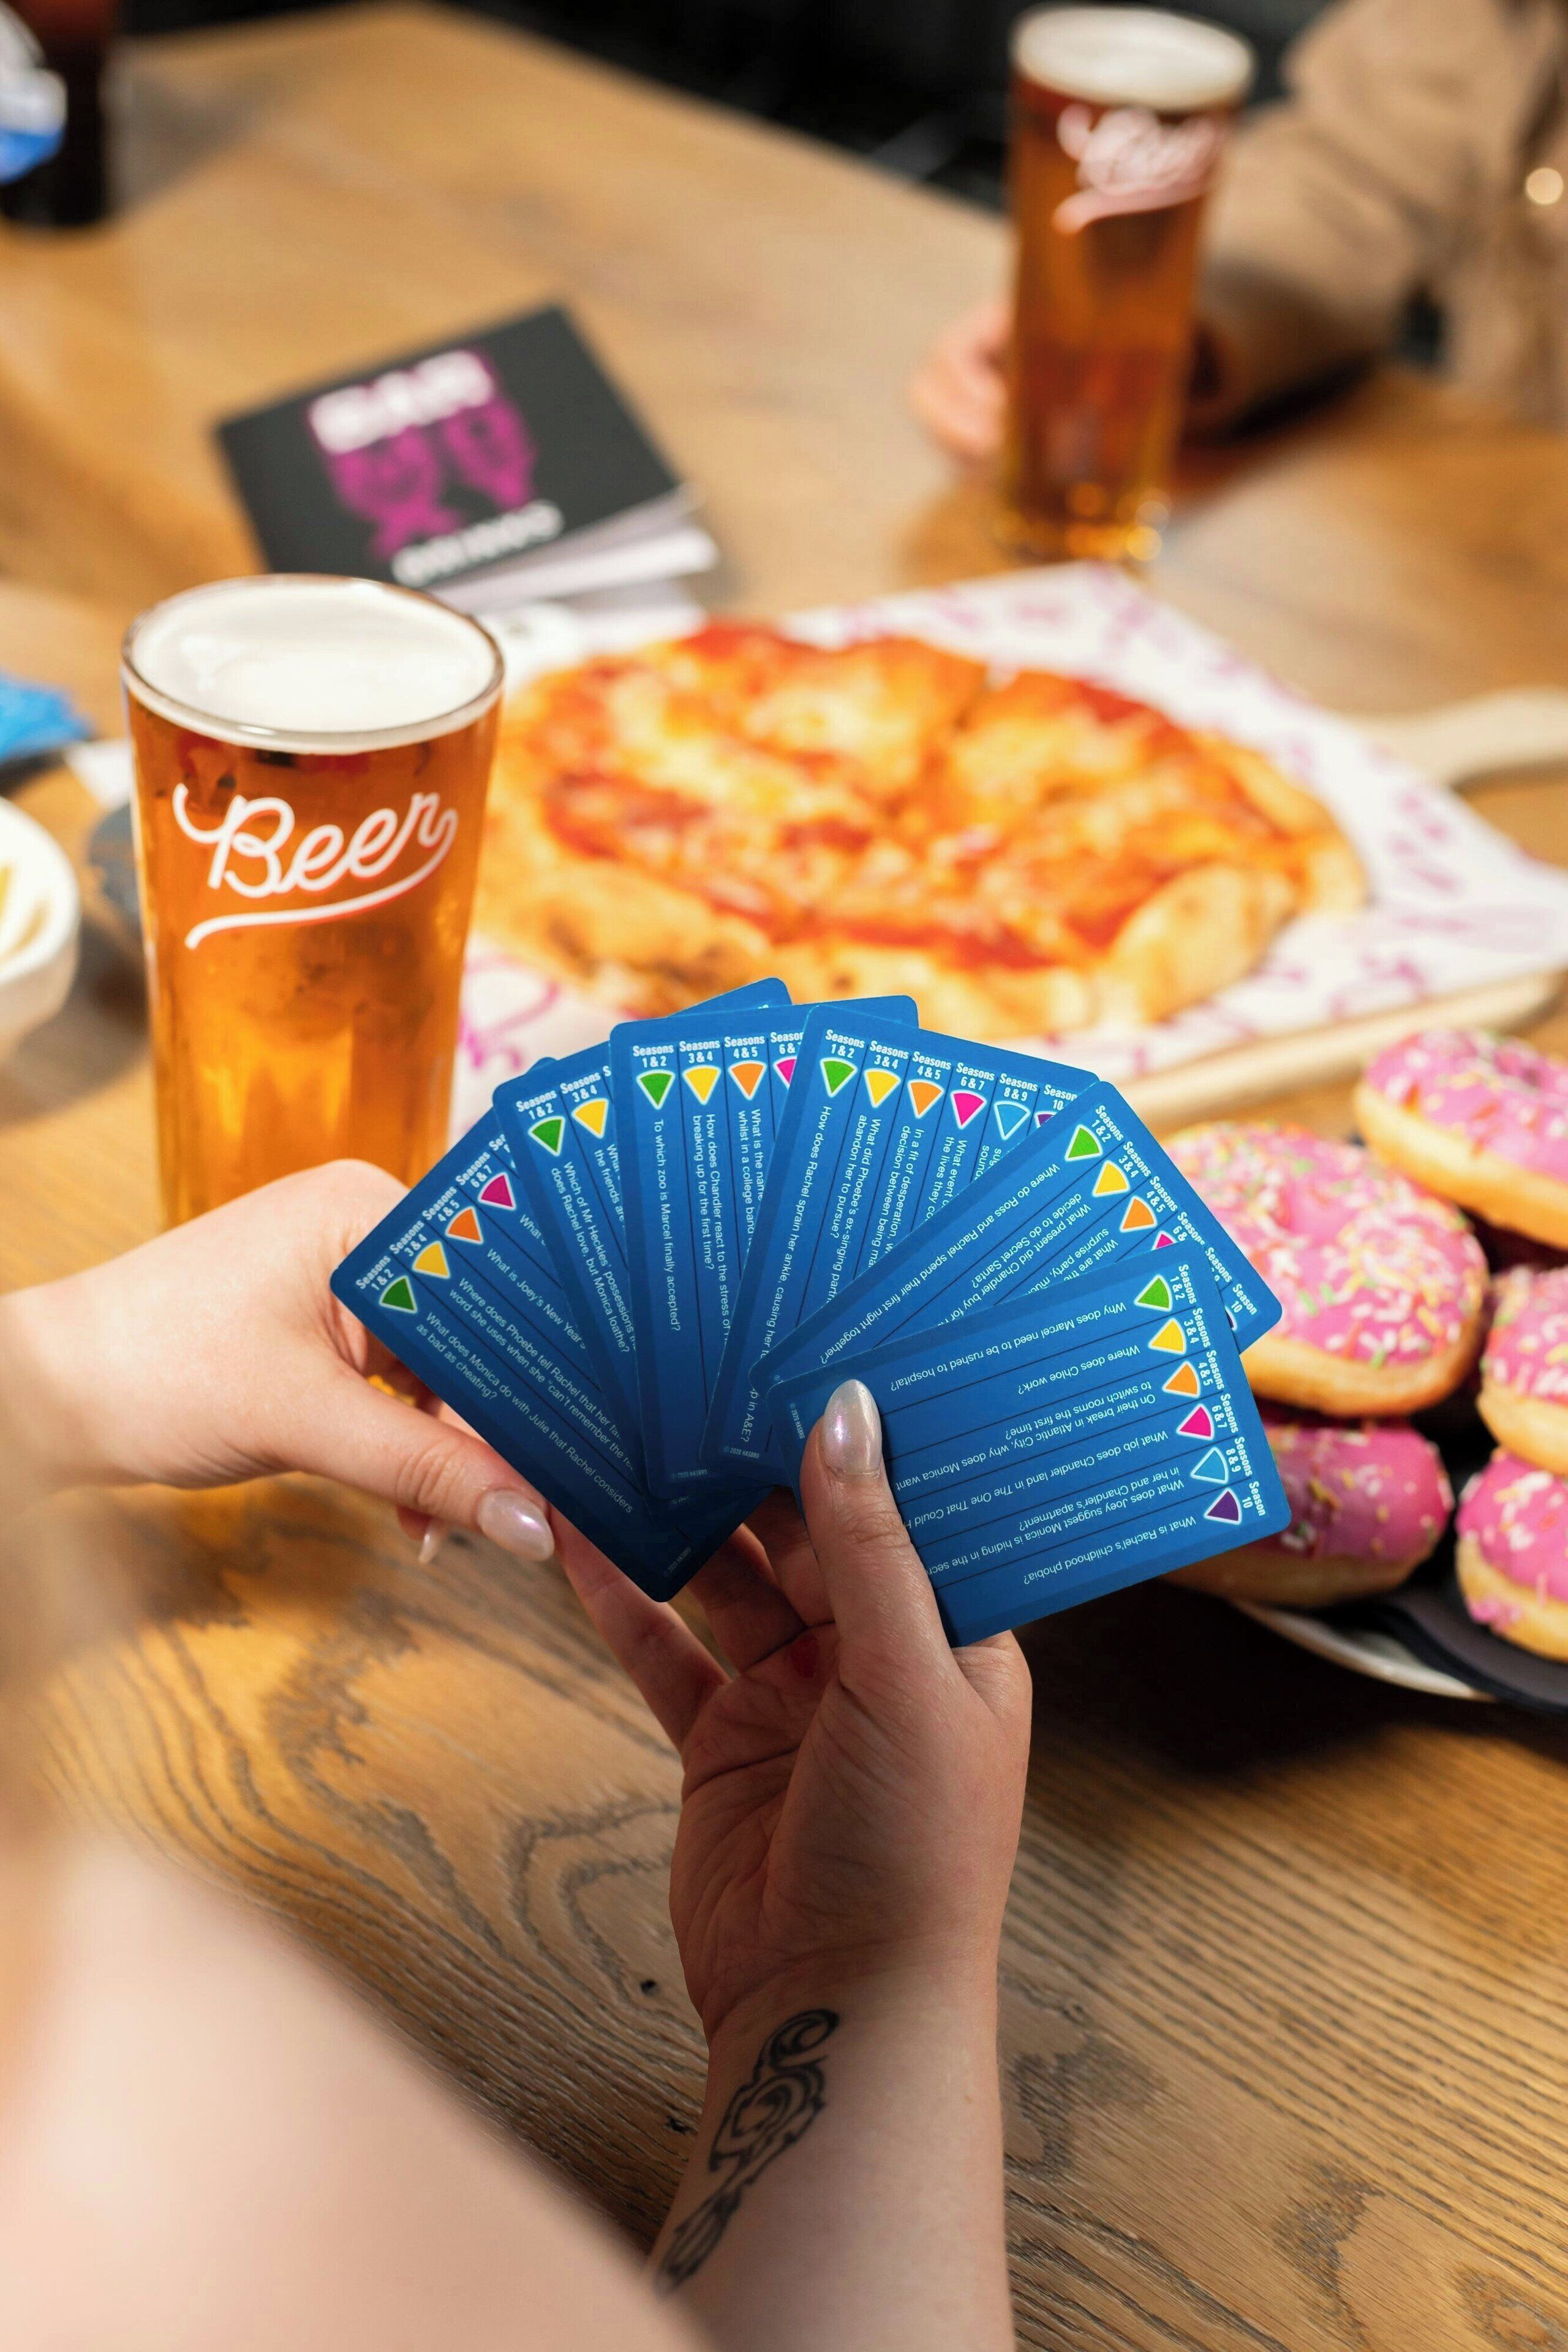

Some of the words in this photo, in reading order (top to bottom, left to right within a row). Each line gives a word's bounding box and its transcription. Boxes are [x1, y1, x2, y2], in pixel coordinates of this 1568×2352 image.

[172, 783, 458, 949] Beer
[679, 1040, 720, 1052] Seasons
[724, 1036, 764, 1047] Seasons
[825, 1029, 865, 1048] Seasons
[633, 1045, 674, 1057] Seasons
[869, 1040, 908, 1059] Seasons
[912, 1051, 951, 1069] Seasons
[956, 1062, 994, 1080] Seasons
[560, 1072, 600, 1094] Seasons
[999, 1072, 1038, 1091] Seasons
[516, 1090, 557, 1112] Seasons
[654, 1119, 663, 1132] To
[818, 1106, 832, 1130] How
[1095, 1105, 1123, 1140] Seasons
[693, 1115, 704, 1161] breaking
[810, 1133, 824, 1158] does
[849, 1115, 867, 1160] abandon
[655, 1135, 666, 1166] which
[1123, 1141, 1151, 1177] Seasons
[455, 1152, 490, 1185] Seasons
[695, 1164, 704, 1178] up
[845, 1163, 856, 1180] her
[1030, 1164, 1060, 1187] Where
[657, 1169, 666, 1188] zoo
[698, 1180, 707, 1194] for
[801, 1161, 818, 1197] Rachel
[660, 1192, 667, 1200] is
[841, 1183, 851, 1193] to
[1017, 1186, 1030, 1197] do
[1150, 1175, 1177, 1211] Seasons
[422, 1186, 456, 1220] Seasons
[699, 1197, 709, 1215] the
[994, 1196, 1019, 1216] Ross
[1052, 1193, 1081, 1218] decide
[661, 1204, 672, 1239] Marcel
[792, 1199, 805, 1231] sprain
[830, 1195, 846, 1238] pursue?
[976, 1215, 994, 1233] and
[1042, 1217, 1053, 1227] to
[701, 1218, 711, 1237] first
[1029, 1226, 1041, 1237] do
[389, 1220, 424, 1254] Seasons
[788, 1234, 799, 1251] her
[946, 1229, 978, 1257] Rachel
[664, 1242, 674, 1272] finally
[703, 1240, 714, 1269] time?
[1000, 1237, 1030, 1262] Secret
[551, 1167, 565, 1193] does
[562, 1194, 582, 1230] Rachel
[576, 1231, 589, 1256] love,
[586, 1257, 598, 1275] but
[593, 1276, 612, 1315] Monica
[608, 1316, 629, 1351] loathe?
[778, 1253, 792, 1283] ankle,
[919, 1254, 947, 1280] spend
[1205, 1246, 1232, 1282] Seasons
[355, 1256, 390, 1289] Seasons
[971, 1260, 1001, 1287] Santa?
[900, 1277, 921, 1295] their
[1178, 1264, 1196, 1304] Seasons
[666, 1276, 680, 1330] accepted?
[766, 1287, 783, 1327] causing
[881, 1294, 900, 1311] first
[1104, 1302, 1126, 1314] Why
[1231, 1300, 1242, 1313] 10
[1232, 1283, 1257, 1315] Season
[859, 1308, 882, 1329] night
[1076, 1310, 1101, 1324] does
[1041, 1319, 1074, 1338] Marcel
[1193, 1308, 1210, 1347] Seasons
[764, 1330, 775, 1347] her
[820, 1327, 861, 1363] together?
[1013, 1332, 1038, 1348] need
[986, 1345, 999, 1355] be
[1107, 1345, 1140, 1360] Where
[416, 1324, 428, 1335] as
[427, 1333, 447, 1352] bad
[444, 1351, 456, 1362] as
[456, 1362, 497, 1399] cheating?
[937, 1363, 948, 1372] to
[949, 1351, 984, 1370] rushed
[1080, 1357, 1105, 1370] does
[891, 1368, 935, 1390] hospital?
[1049, 1366, 1079, 1381] Chloe
[1206, 1350, 1224, 1390] Seasons
[1018, 1377, 1047, 1394] work?
[1106, 1385, 1138, 1403] switch
[1140, 1381, 1151, 1390] to
[747, 1401, 758, 1410] in
[1072, 1397, 1104, 1414] rooms
[1117, 1400, 1138, 1413] their
[1140, 1394, 1155, 1404] On
[426, 1312, 449, 1336] What
[448, 1336, 469, 1357] does
[469, 1354, 499, 1385] Monica
[499, 1385, 511, 1396] do
[511, 1396, 529, 1414] with
[529, 1414, 549, 1433] Julie
[549, 1431, 567, 1449] that
[565, 1447, 596, 1476] Rachel
[594, 1475, 632, 1512] considers
[1055, 1409, 1071, 1420] the
[1085, 1408, 1114, 1423] break
[1220, 1393, 1238, 1433] Seasons
[741, 1413, 754, 1442] A&E?
[1033, 1415, 1053, 1428] first
[1005, 1423, 1032, 1439] time?
[1035, 1422, 1071, 1441] Atlantic
[1140, 1430, 1168, 1446] What
[989, 1445, 1009, 1457] why
[1011, 1436, 1033, 1448] City,
[1123, 1438, 1139, 1451] job
[961, 1453, 986, 1466] does
[1096, 1446, 1121, 1460] does
[1234, 1436, 1252, 1476] Seasons
[922, 1462, 960, 1480] Monica
[1050, 1456, 1095, 1477] Chandler
[895, 1476, 921, 1490] want
[1026, 1472, 1048, 1487] land
[1130, 1477, 1149, 1491] and
[1152, 1471, 1168, 1482] her
[993, 1485, 1012, 1496] The
[1130, 1489, 1155, 1502] does
[1157, 1479, 1184, 1494] What
[971, 1492, 991, 1504] One
[1076, 1485, 1128, 1509] Chandler's
[1105, 1498, 1128, 1512] Joey
[1242, 1496, 1253, 1508] 10
[1248, 1481, 1265, 1515] Season
[946, 1500, 968, 1515] That
[914, 1509, 943, 1526] Could
[1019, 1504, 1074, 1531] apartment?
[1063, 1507, 1102, 1528] suggest
[1169, 1516, 1196, 1531] What
[1024, 1522, 1061, 1540] Monica
[1158, 1525, 1167, 1534] is
[981, 1540, 1012, 1555] hiding
[1014, 1536, 1023, 1544] is
[1115, 1529, 1156, 1550] Rachel's
[952, 1555, 968, 1566] the
[970, 1551, 980, 1559] in
[1064, 1545, 1112, 1569] childhood
[1023, 1561, 1062, 1584] phobia?
